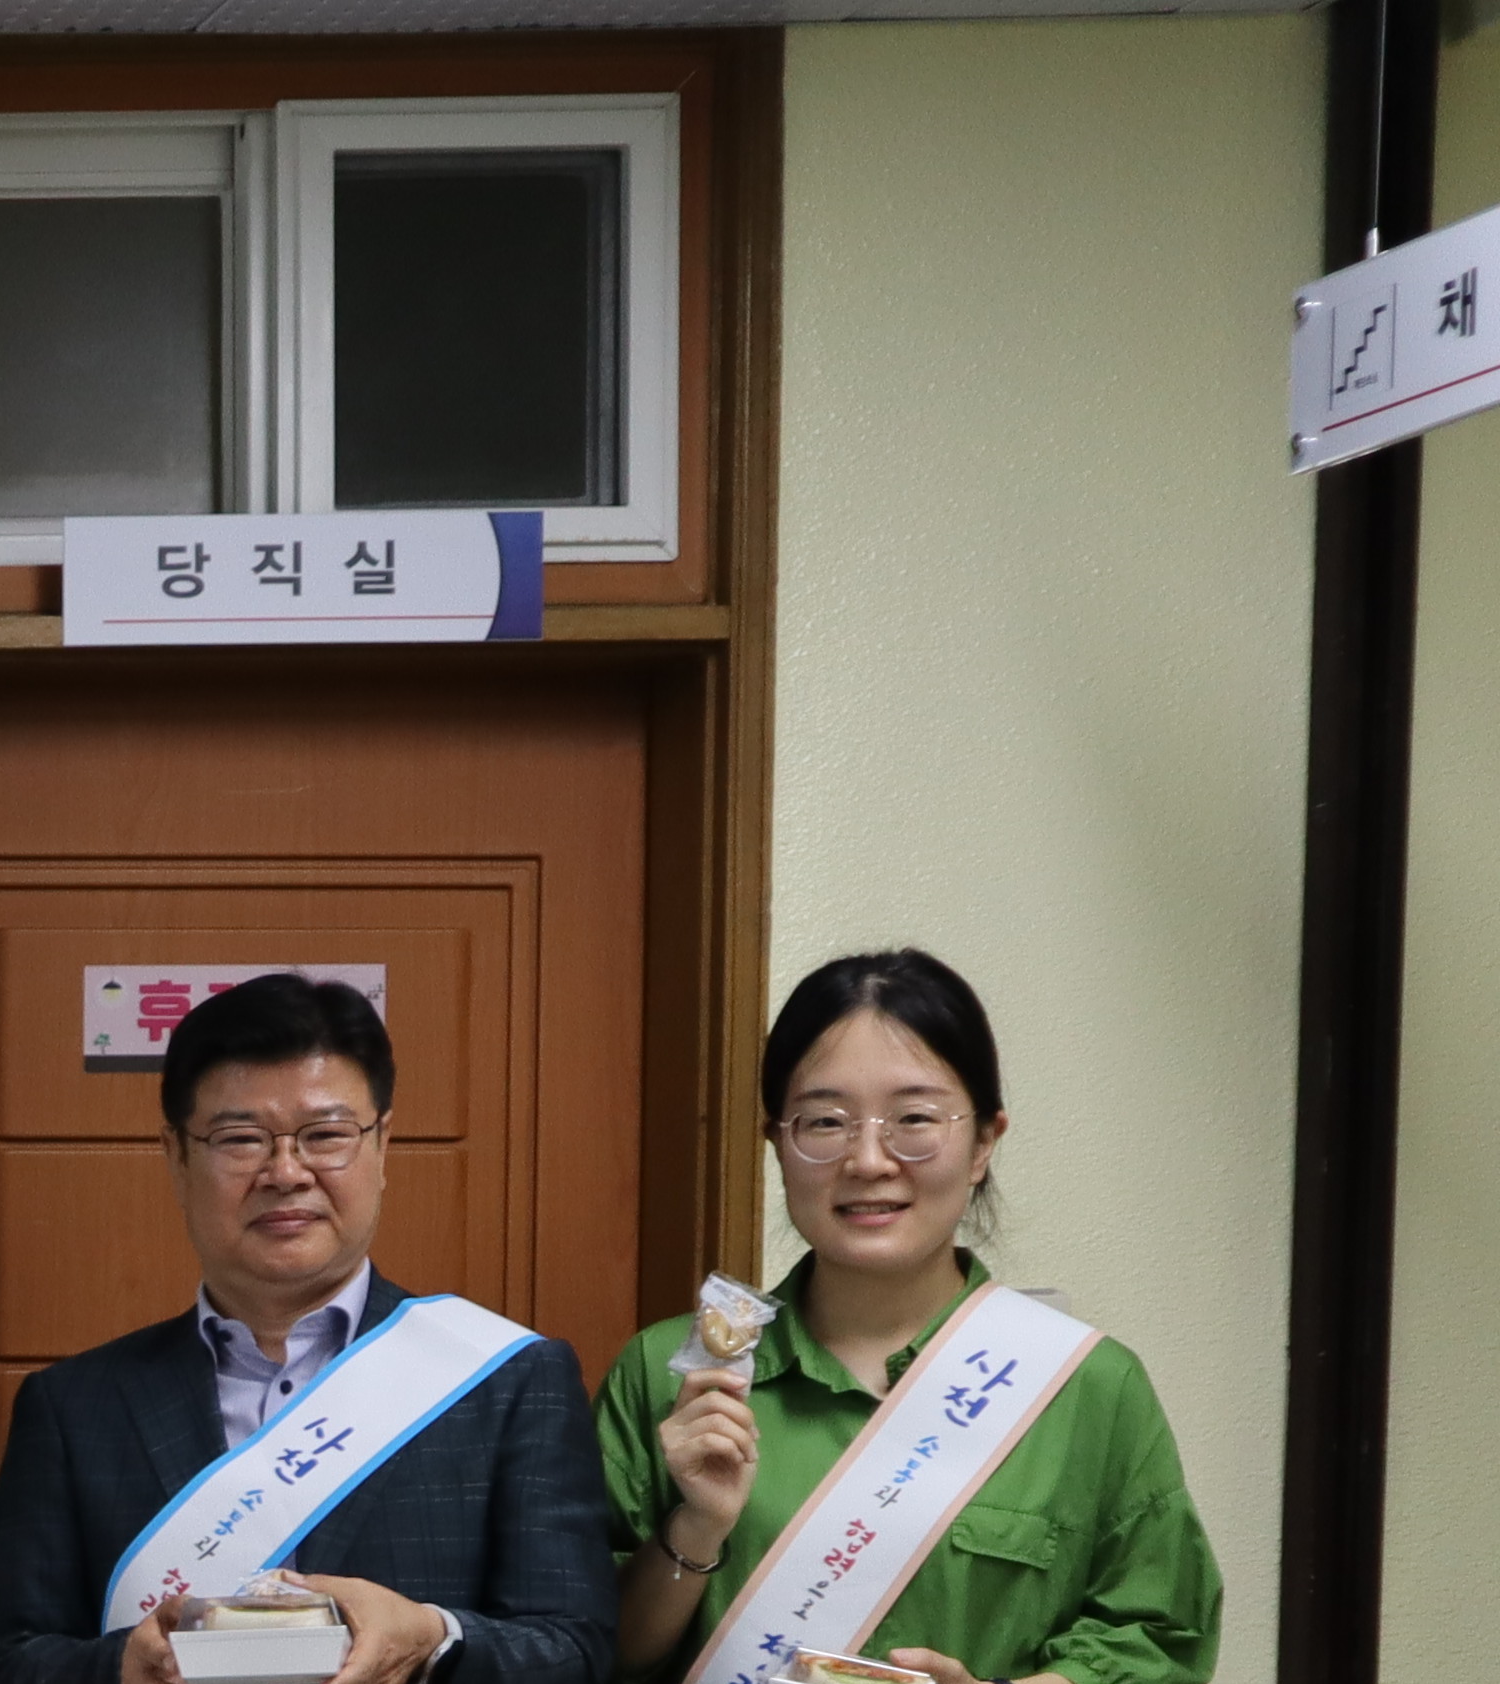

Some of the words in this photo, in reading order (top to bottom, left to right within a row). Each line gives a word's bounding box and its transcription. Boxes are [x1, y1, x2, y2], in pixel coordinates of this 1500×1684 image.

[155, 538, 399, 598] 당직실
[944, 1349, 1021, 1428] 사천
[274, 1416, 356, 1486] 사천
[873, 1435, 942, 1509] 소통과
[193, 1488, 265, 1561] 소통과
[793, 1518, 877, 1621] 협력으로
